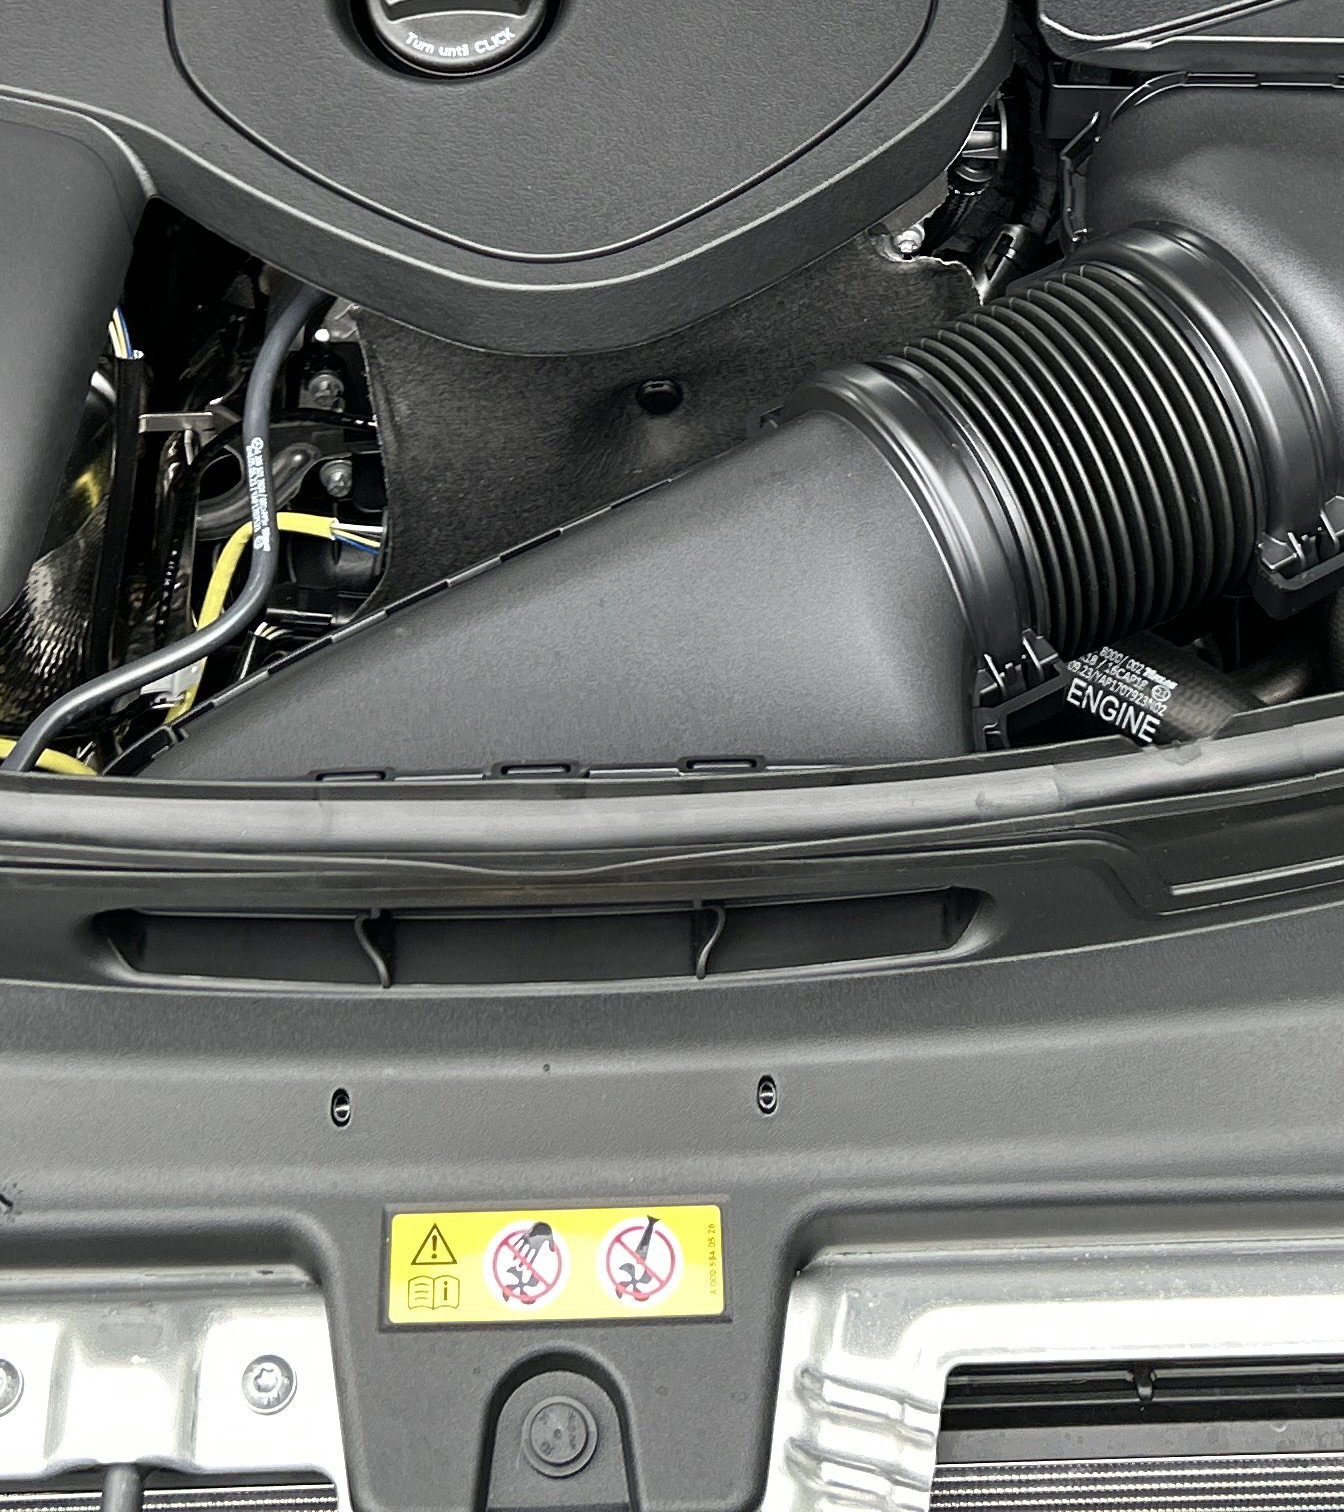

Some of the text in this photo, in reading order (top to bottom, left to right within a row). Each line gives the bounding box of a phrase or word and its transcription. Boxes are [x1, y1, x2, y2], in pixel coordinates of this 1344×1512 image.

[406, 27, 516, 57] Turn until CLICK
[1066, 677, 1161, 743] ENGINE
